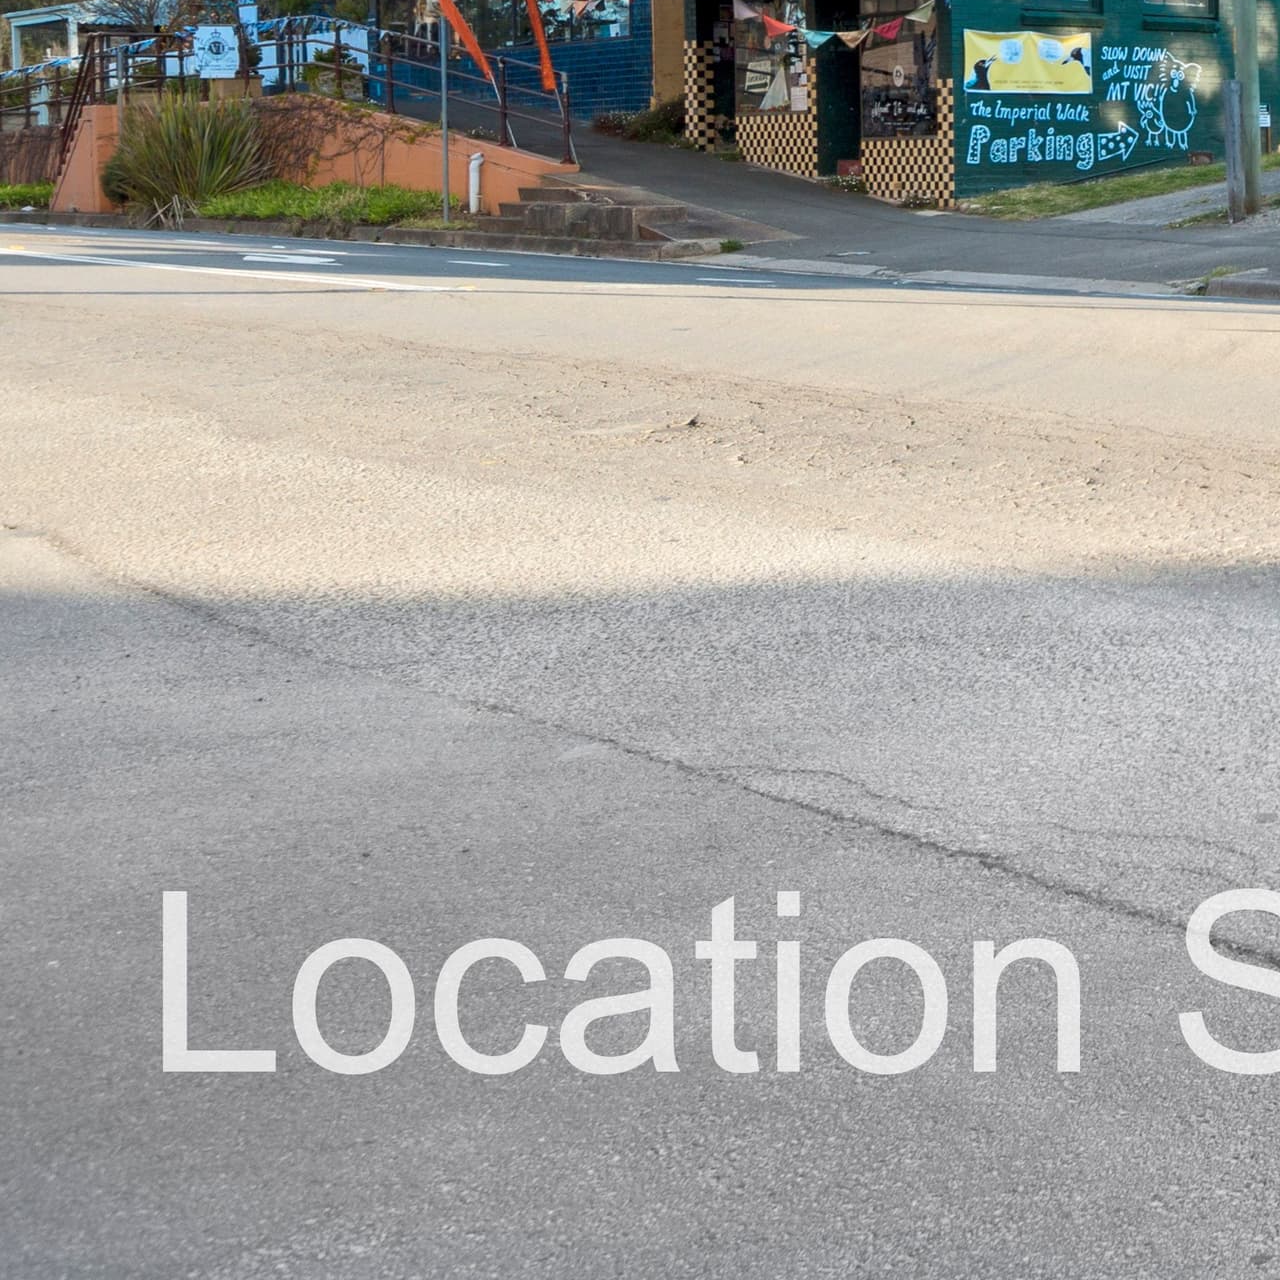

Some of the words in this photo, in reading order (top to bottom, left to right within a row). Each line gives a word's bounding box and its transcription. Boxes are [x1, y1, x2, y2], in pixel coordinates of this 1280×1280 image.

[1101, 46, 1128, 60] SLOW
[1132, 46, 1166, 61] DOWN
[1102, 60, 1120, 80] and
[1106, 81, 1130, 101] MT
[970, 100, 992, 118] The
[995, 100, 1051, 127] Imperial
[1056, 103, 1091, 122] Walk
[966, 125, 1094, 170] Parking
